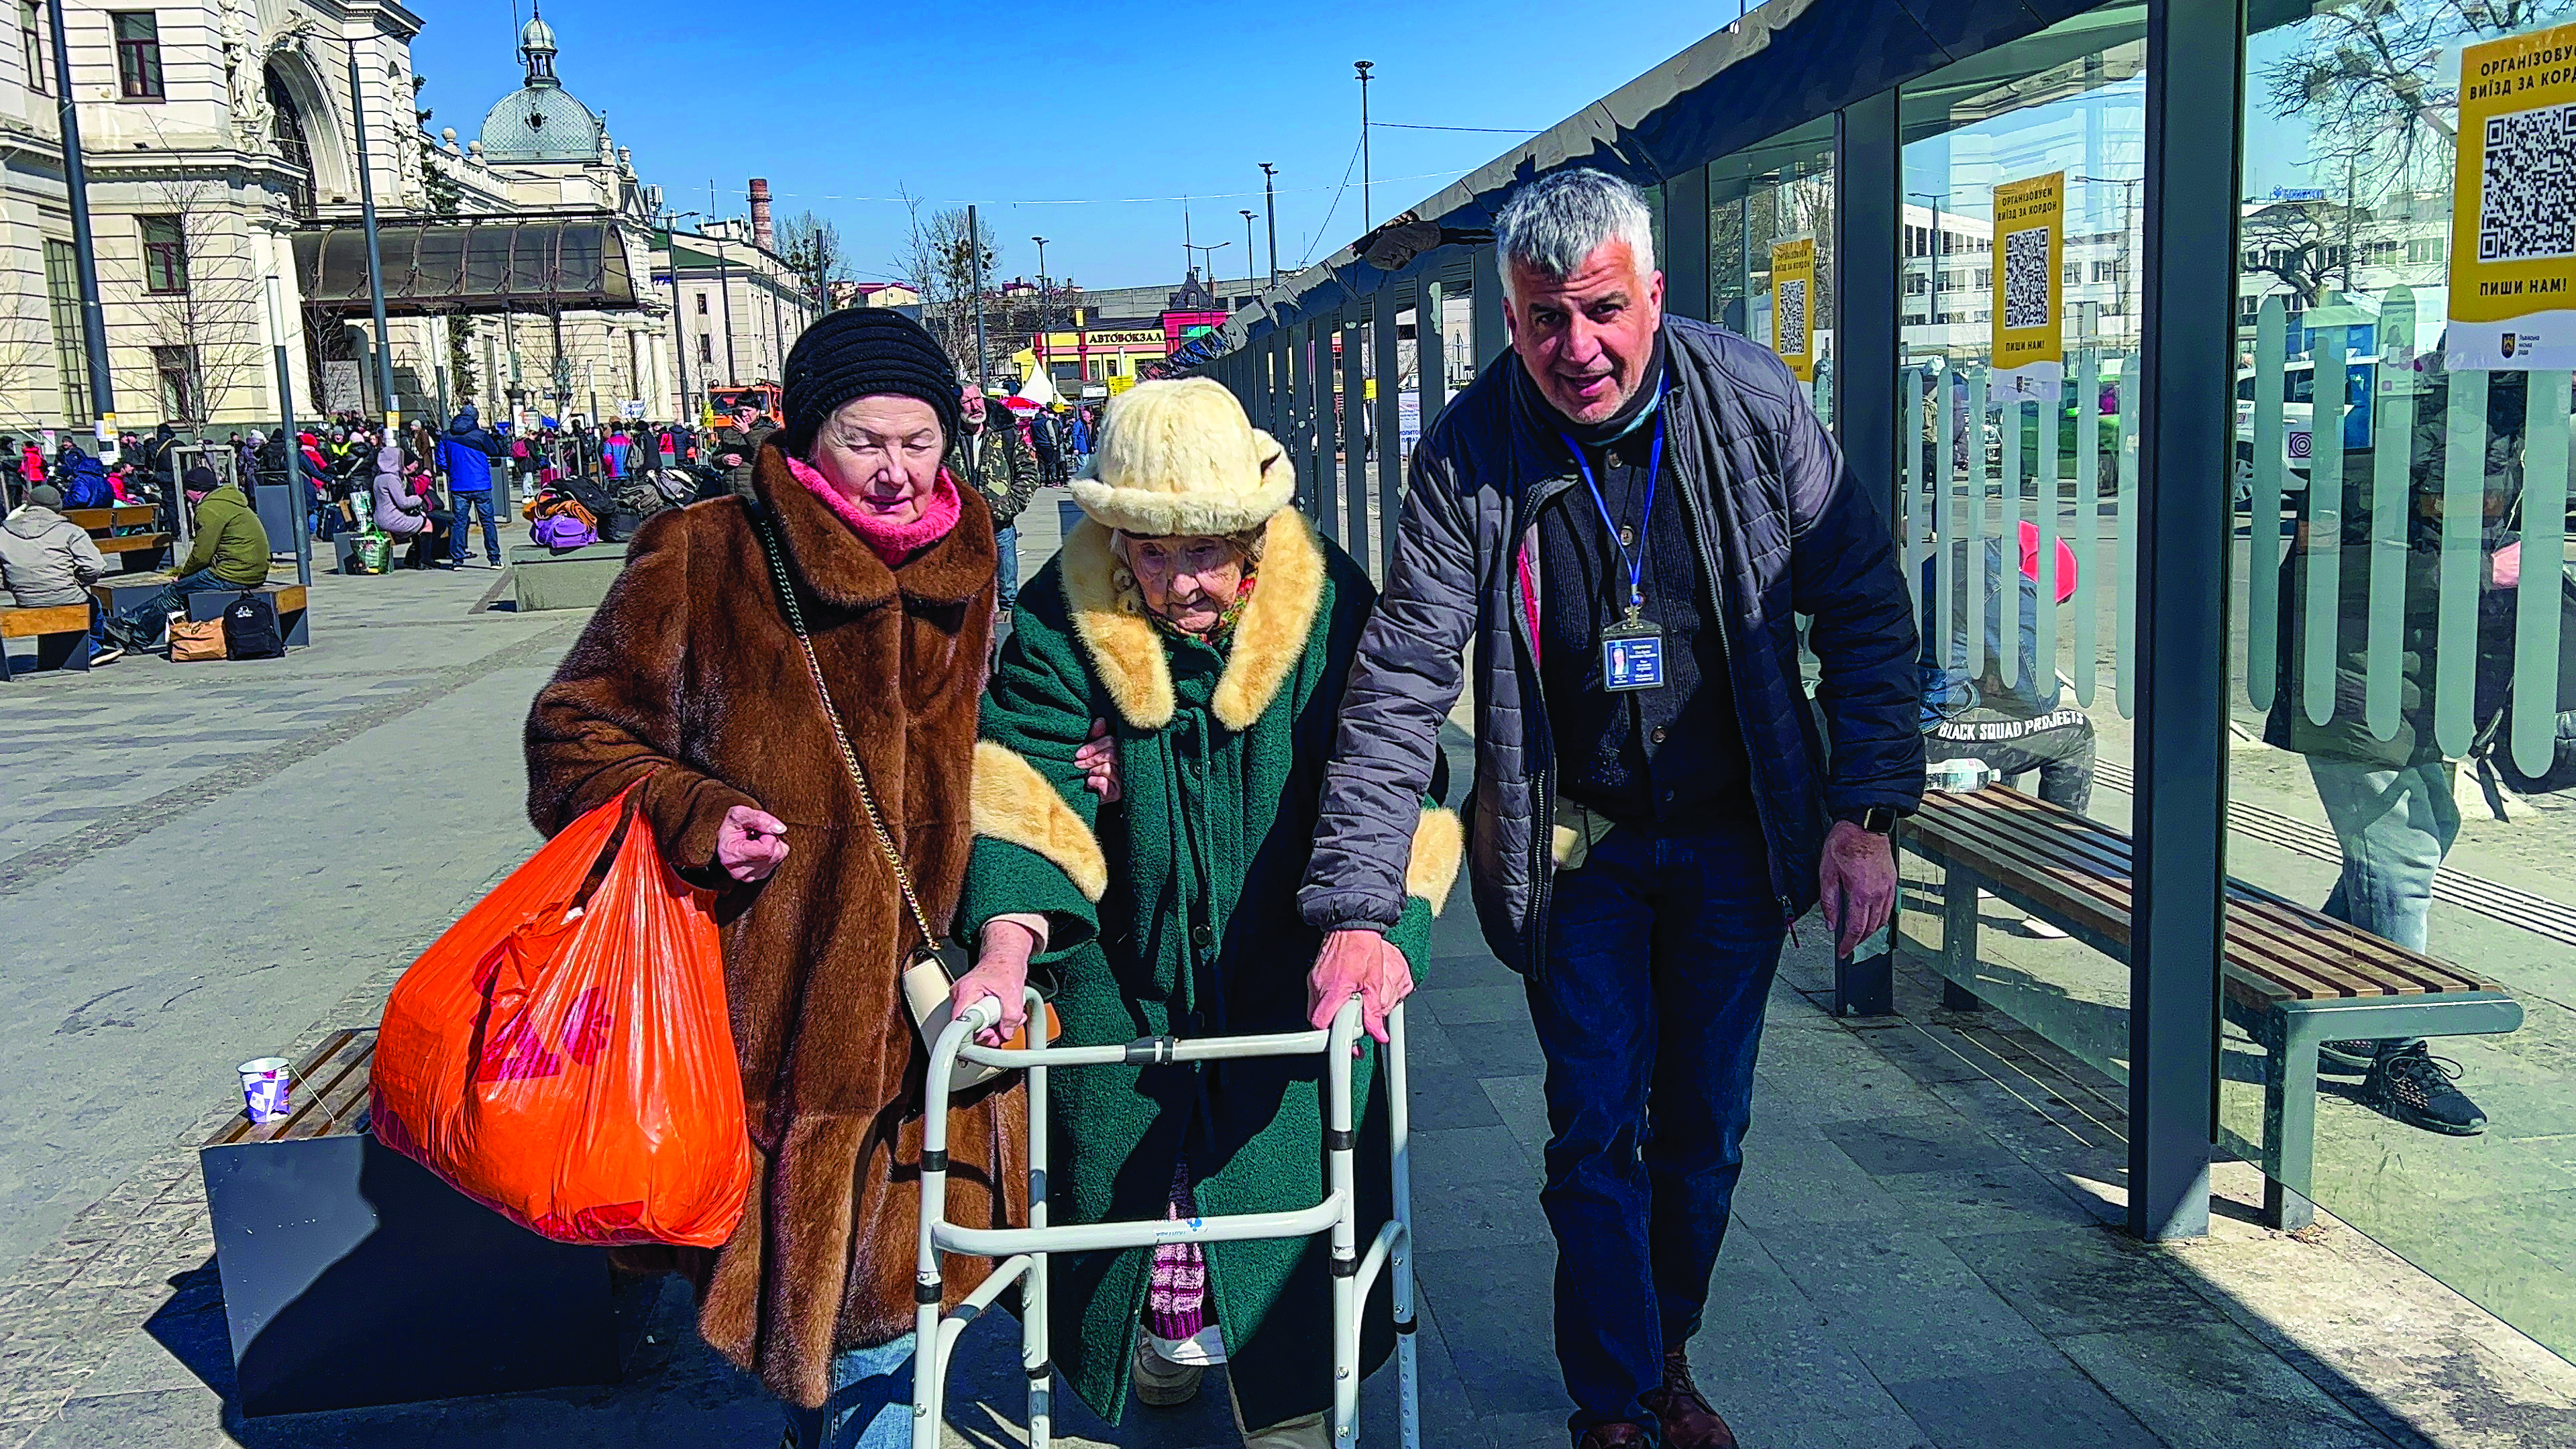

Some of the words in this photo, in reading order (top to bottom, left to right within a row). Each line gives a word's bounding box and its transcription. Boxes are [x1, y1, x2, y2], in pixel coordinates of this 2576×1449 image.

[2481, 44, 2576, 76] ОРГАНІЗОВУ
[2470, 78, 2511, 100] ВИЇЗД
[2518, 74, 2534, 91] ЗА
[2029, 201, 2057, 215] КОРДОН
[2480, 280, 2523, 296] ПИШИ
[2530, 278, 2567, 293] НАМ!
[2006, 341, 2025, 352] ПИШИ
[2027, 339, 2045, 350] НАМ!
[1938, 722, 1976, 740] BLACK
[1980, 722, 2022, 740] SQUAD
[2024, 711, 2084, 735] PROJECTS
